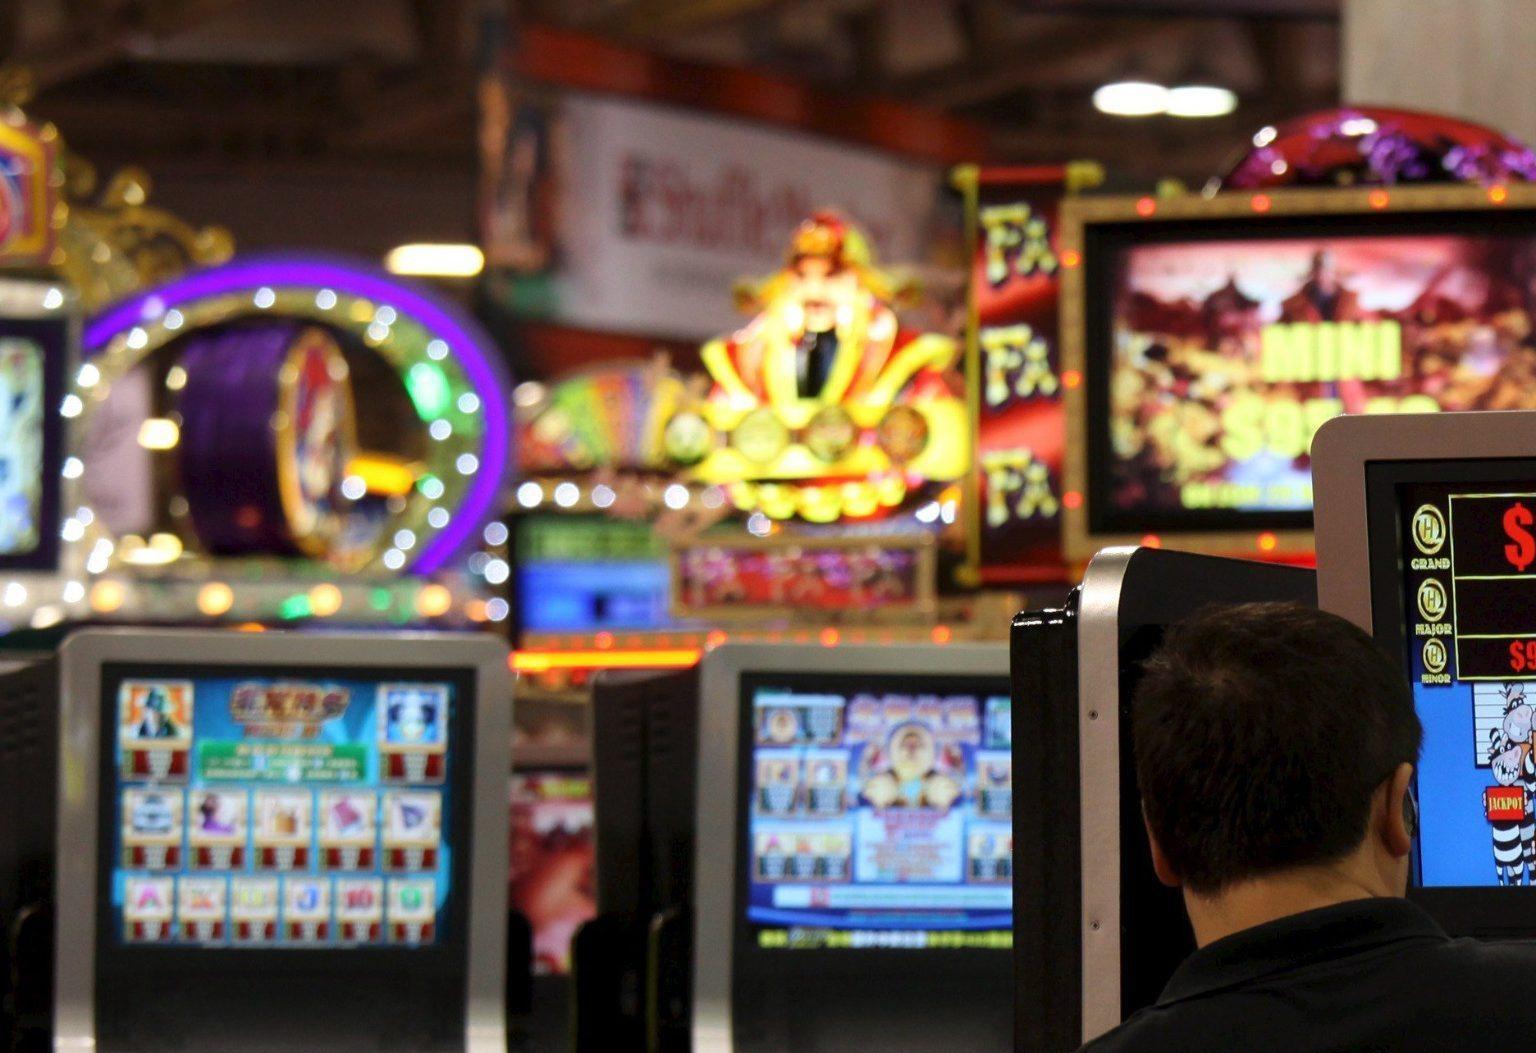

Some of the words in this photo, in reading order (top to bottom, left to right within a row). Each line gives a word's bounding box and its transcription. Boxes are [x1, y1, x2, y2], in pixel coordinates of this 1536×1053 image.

[1411, 558, 1450, 570] GRAND
[1416, 624, 1452, 636] MAJOR
[1422, 674, 1451, 684] MINOR
[1488, 796, 1523, 813] JACKPOT
